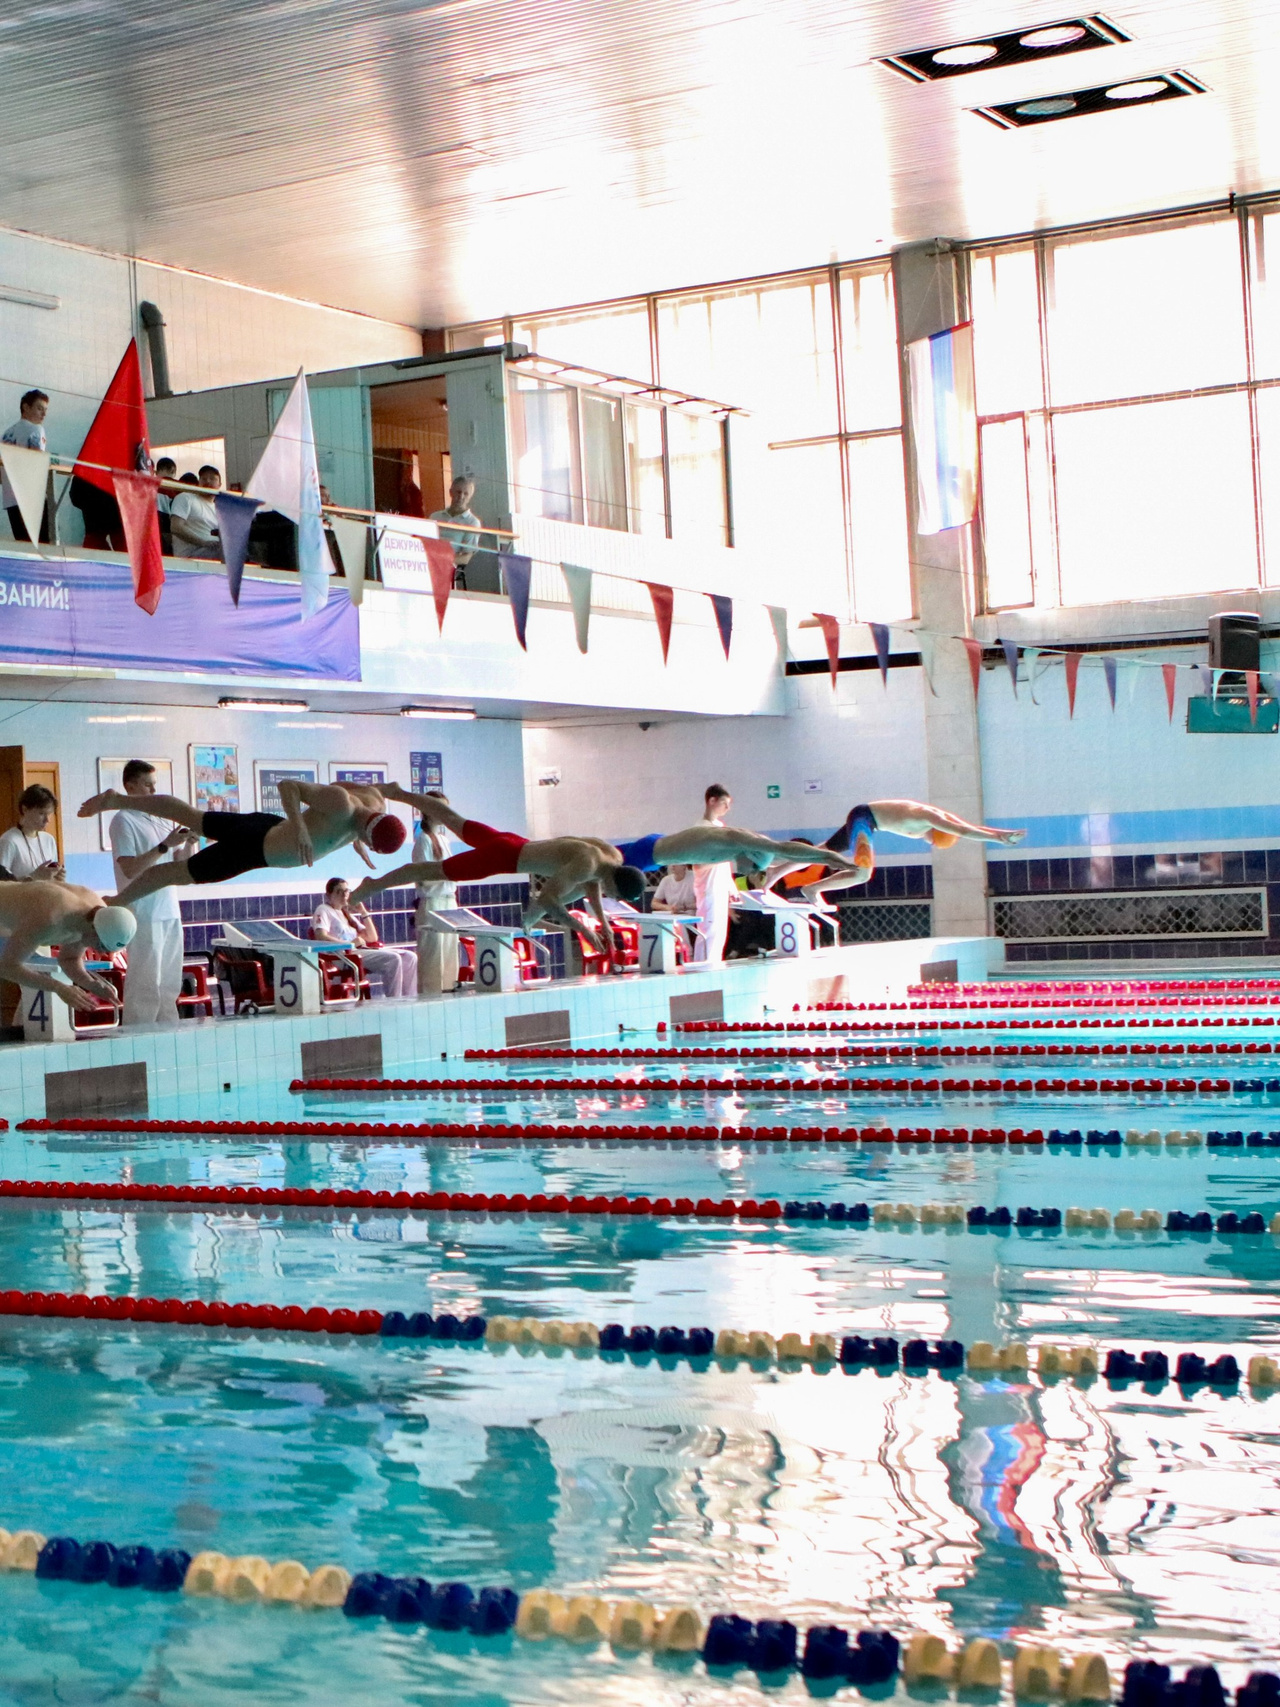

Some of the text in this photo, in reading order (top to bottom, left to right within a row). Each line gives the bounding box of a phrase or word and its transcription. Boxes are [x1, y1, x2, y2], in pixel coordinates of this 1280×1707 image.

[384, 537, 424, 553] ДЕЖУРНЫ
[384, 558, 428, 573] ИНСТРУКТ
[642, 934, 659, 968] 7
[781, 922, 797, 953] 8
[479, 948, 497, 987] 6
[279, 966, 299, 1007] 5
[28, 989, 49, 1032] 4
